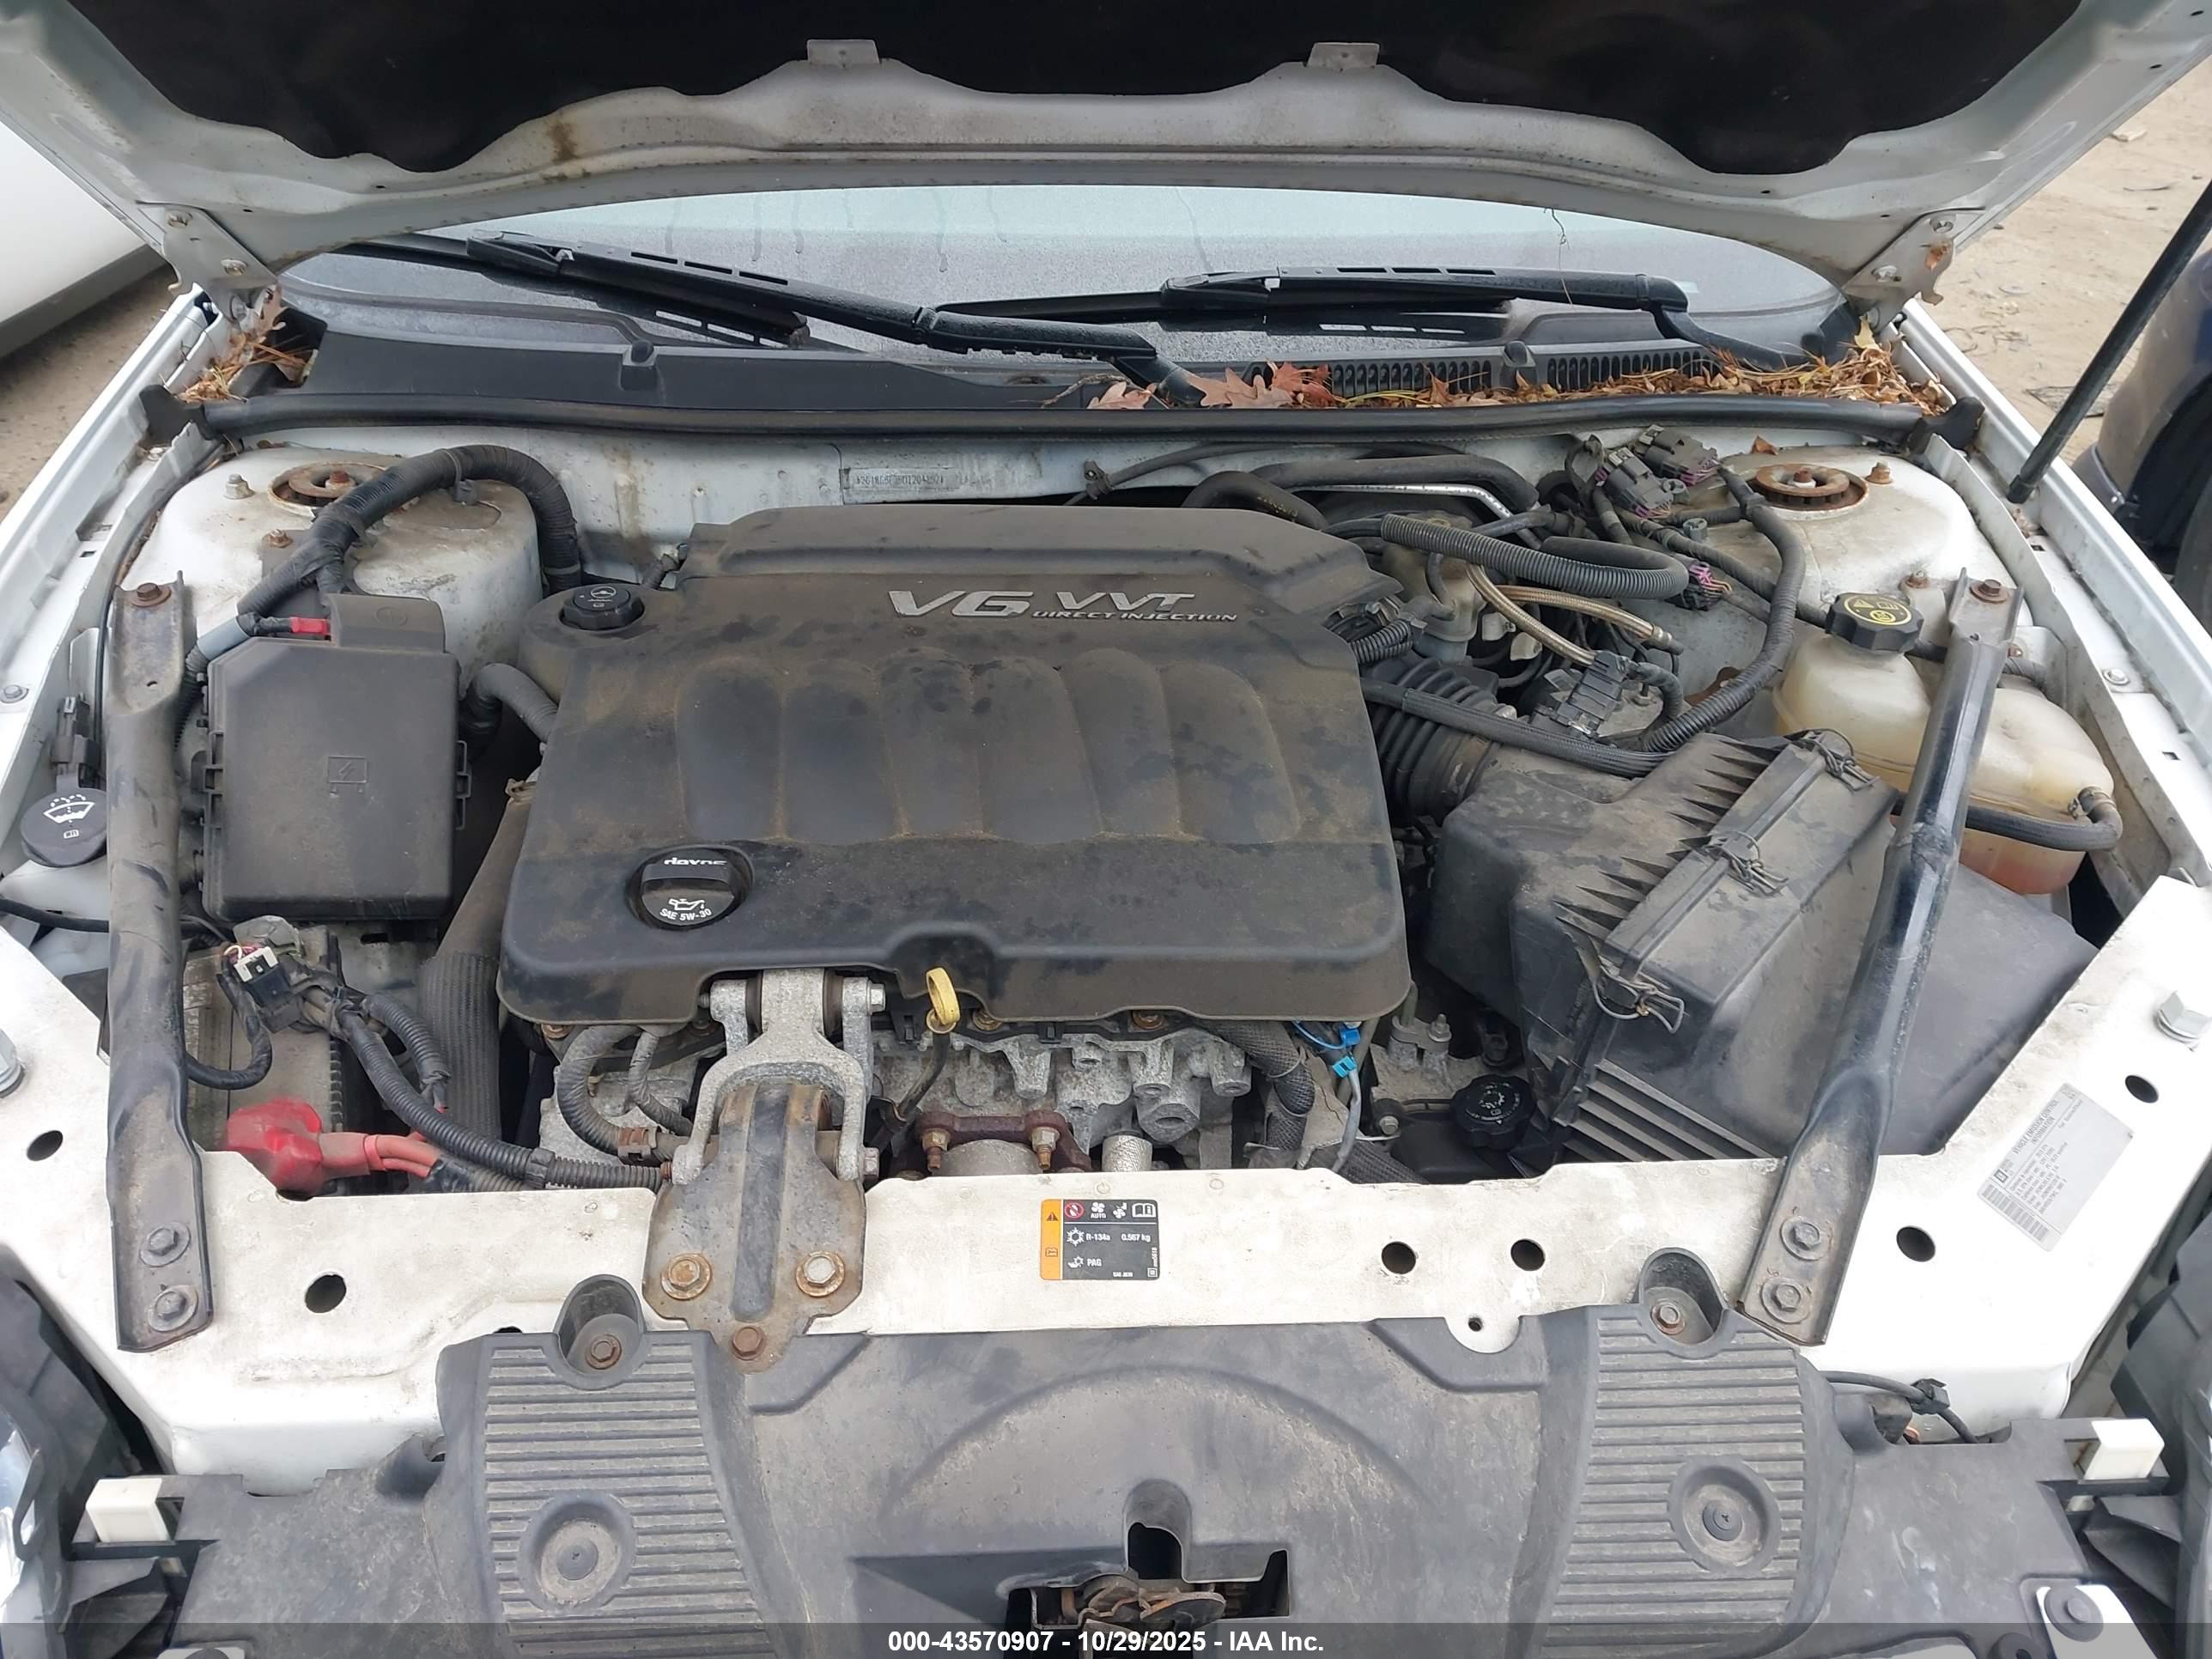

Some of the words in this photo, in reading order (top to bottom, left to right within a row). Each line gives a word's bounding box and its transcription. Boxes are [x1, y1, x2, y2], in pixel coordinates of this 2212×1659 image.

[888, 590, 1033, 617] V6
[1055, 591, 1194, 611] VVT
[1031, 611, 1116, 619] DIRECT
[1120, 611, 1237, 621] INJECTION
[659, 908, 678, 921] SAE
[679, 908, 712, 921] 5W-30
[1085, 1233, 1110, 1242] R-134a
[1141, 1233, 1151, 1243] kg
[1086, 1258, 1103, 1267] PAG
